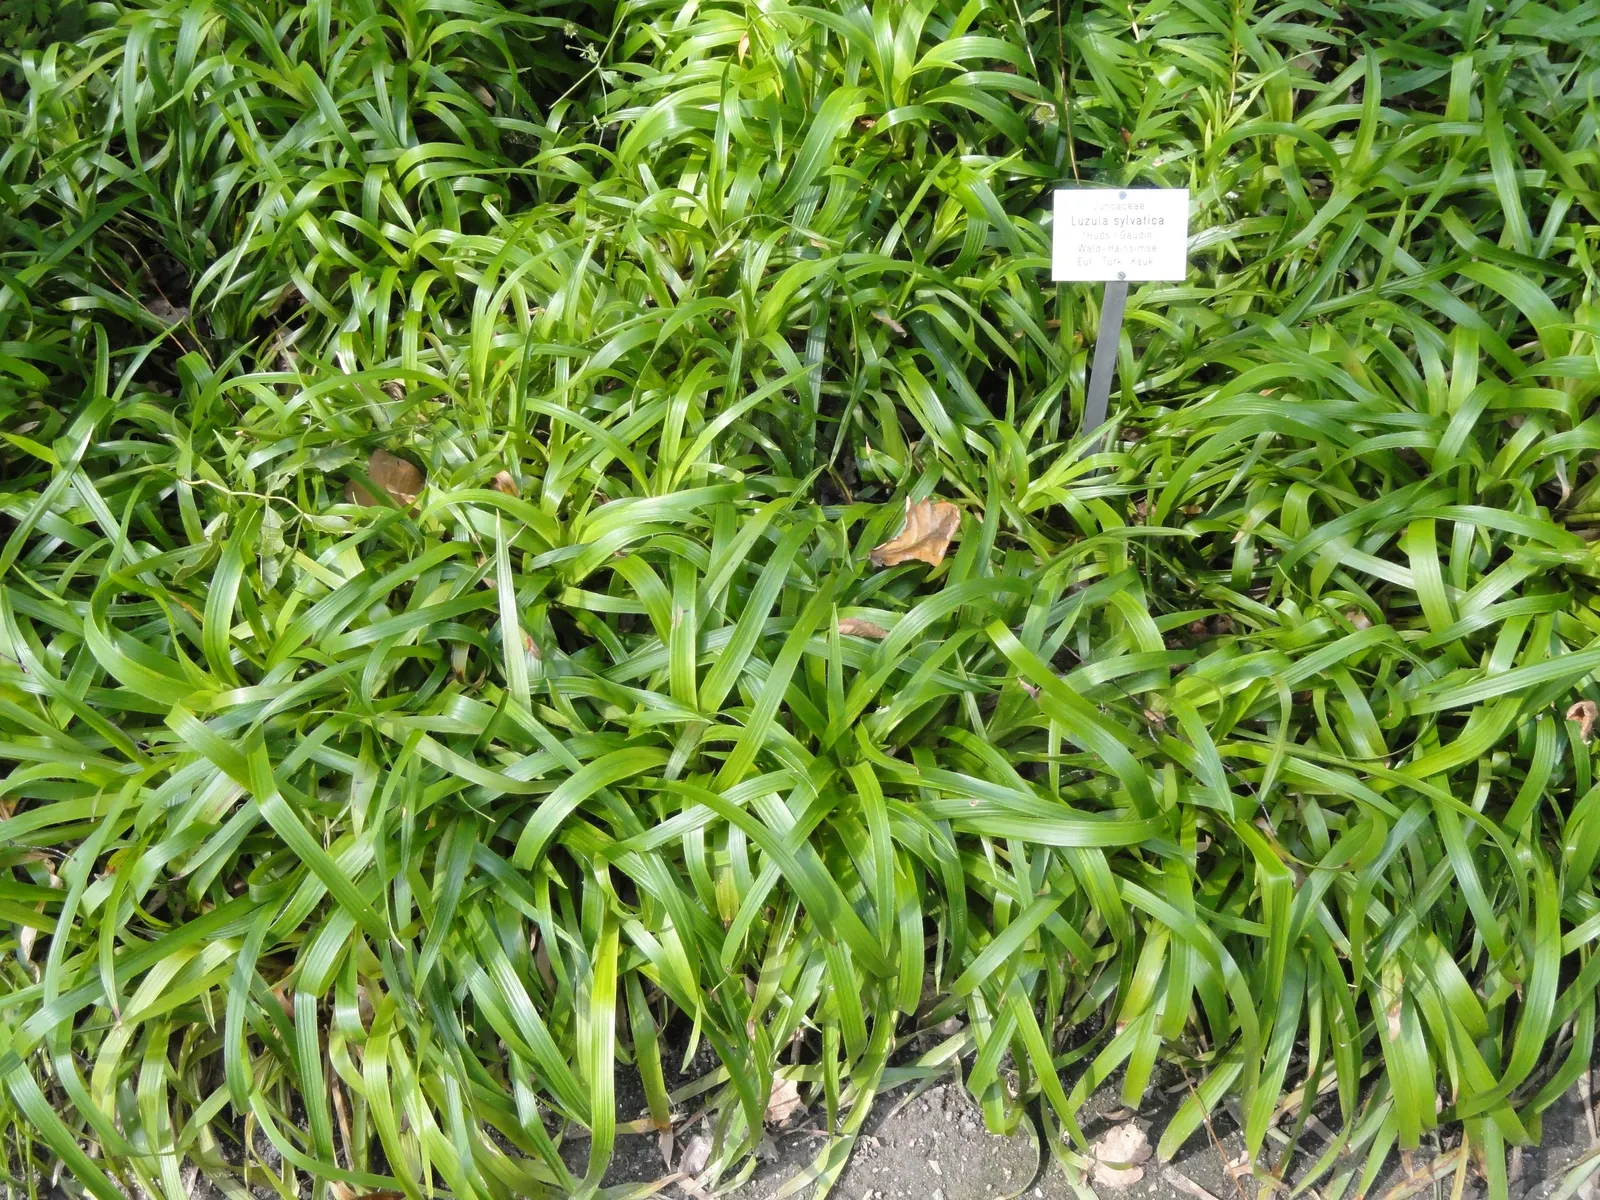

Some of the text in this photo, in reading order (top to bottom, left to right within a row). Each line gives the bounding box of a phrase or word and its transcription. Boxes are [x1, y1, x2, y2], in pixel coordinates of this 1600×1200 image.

[1071, 215, 1165, 228] Luzula sylvatica
[1120, 229, 1153, 240] Gaudin
